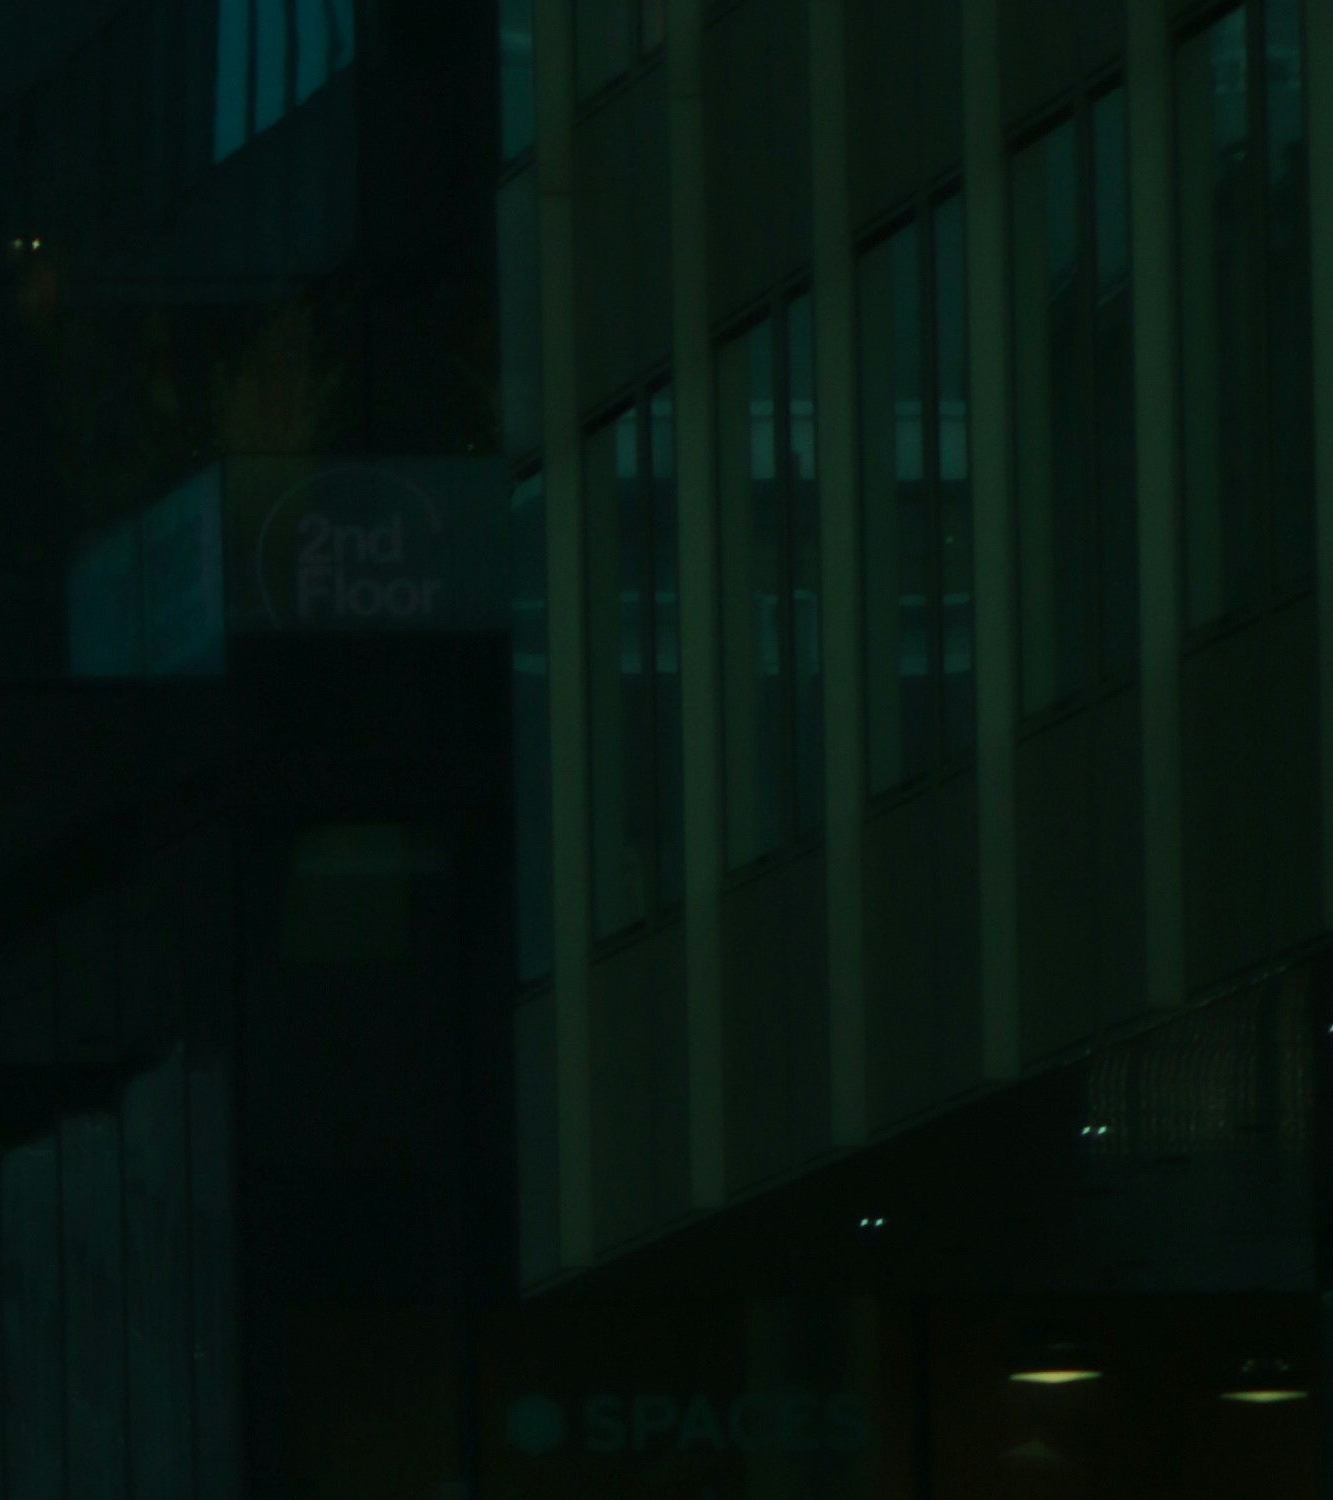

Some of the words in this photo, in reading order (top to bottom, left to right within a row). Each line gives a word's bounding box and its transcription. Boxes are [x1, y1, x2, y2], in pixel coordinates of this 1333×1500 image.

[296, 511, 404, 562] 2nd
[296, 563, 441, 617] Floor
[581, 1391, 867, 1454] SPACES
